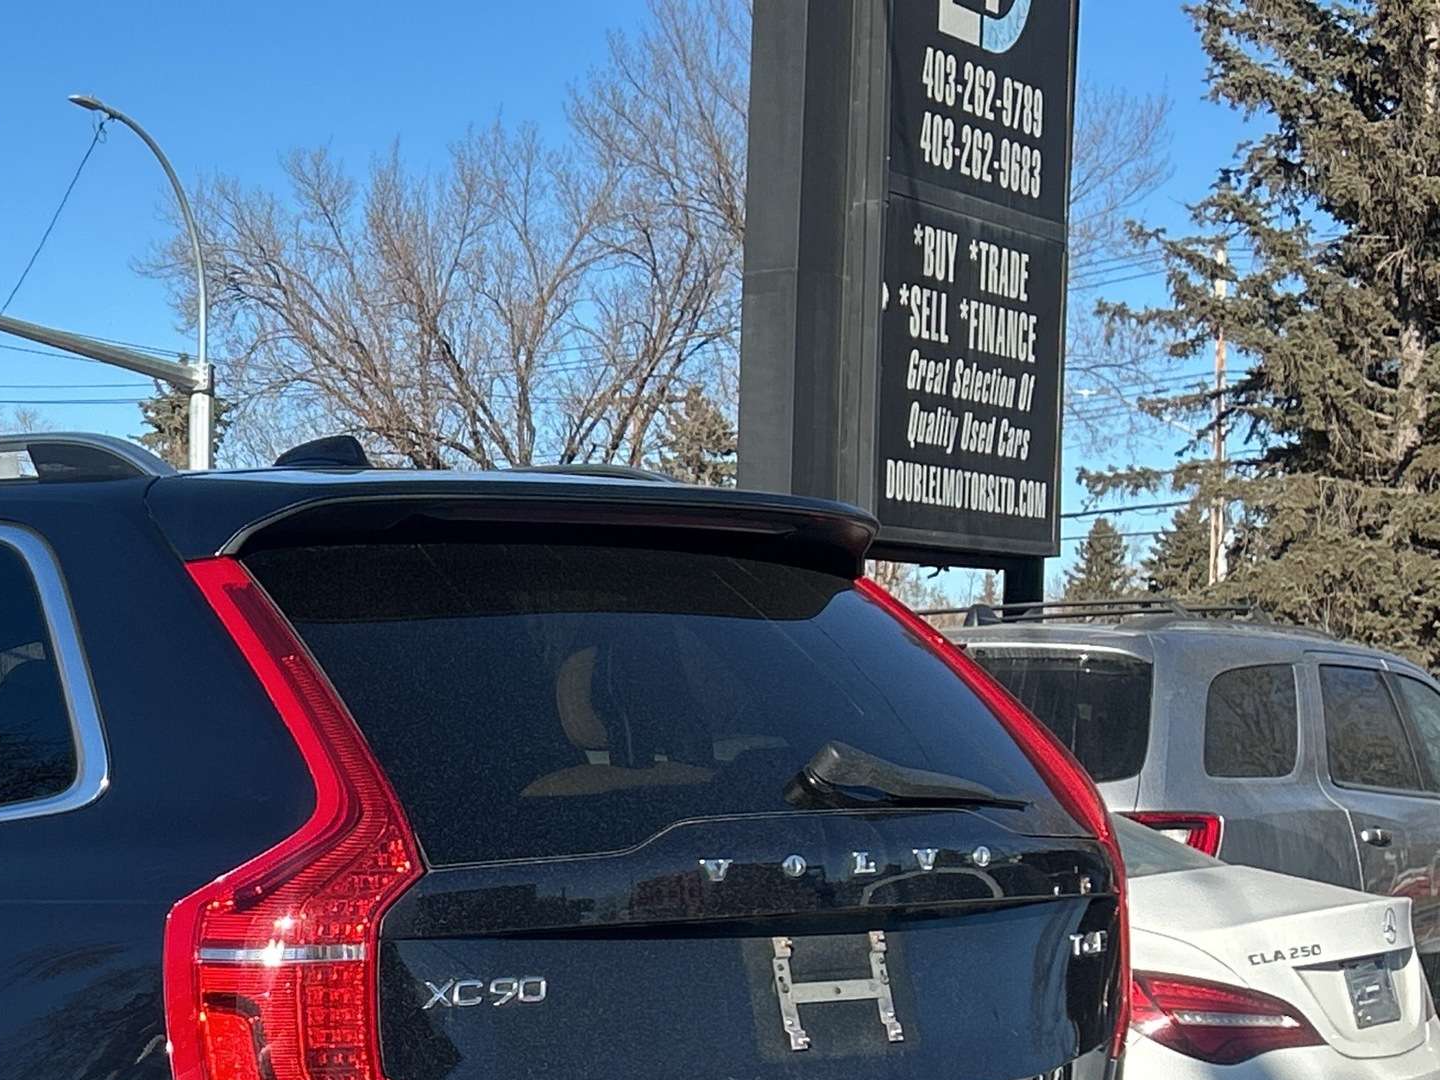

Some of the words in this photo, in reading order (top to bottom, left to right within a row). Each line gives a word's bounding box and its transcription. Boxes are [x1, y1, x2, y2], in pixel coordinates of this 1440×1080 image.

[922, 46, 1043, 138] 403-262-9789
[920, 111, 1041, 199] 403-262-9683
[907, 349, 951, 395] Great
[952, 358, 1017, 408] Selection
[1018, 372, 1036, 412] Of
[907, 401, 959, 454] Quality
[961, 411, 997, 454] Used
[997, 418, 1031, 461] Cars
[886, 459, 1047, 519] DOUBLELMOTORSLTD.COM
[699, 846, 991, 882] VOLVO
[1248, 949, 1286, 966] CLA
[1290, 944, 1322, 960] 250
[421, 977, 546, 1010] XC90
